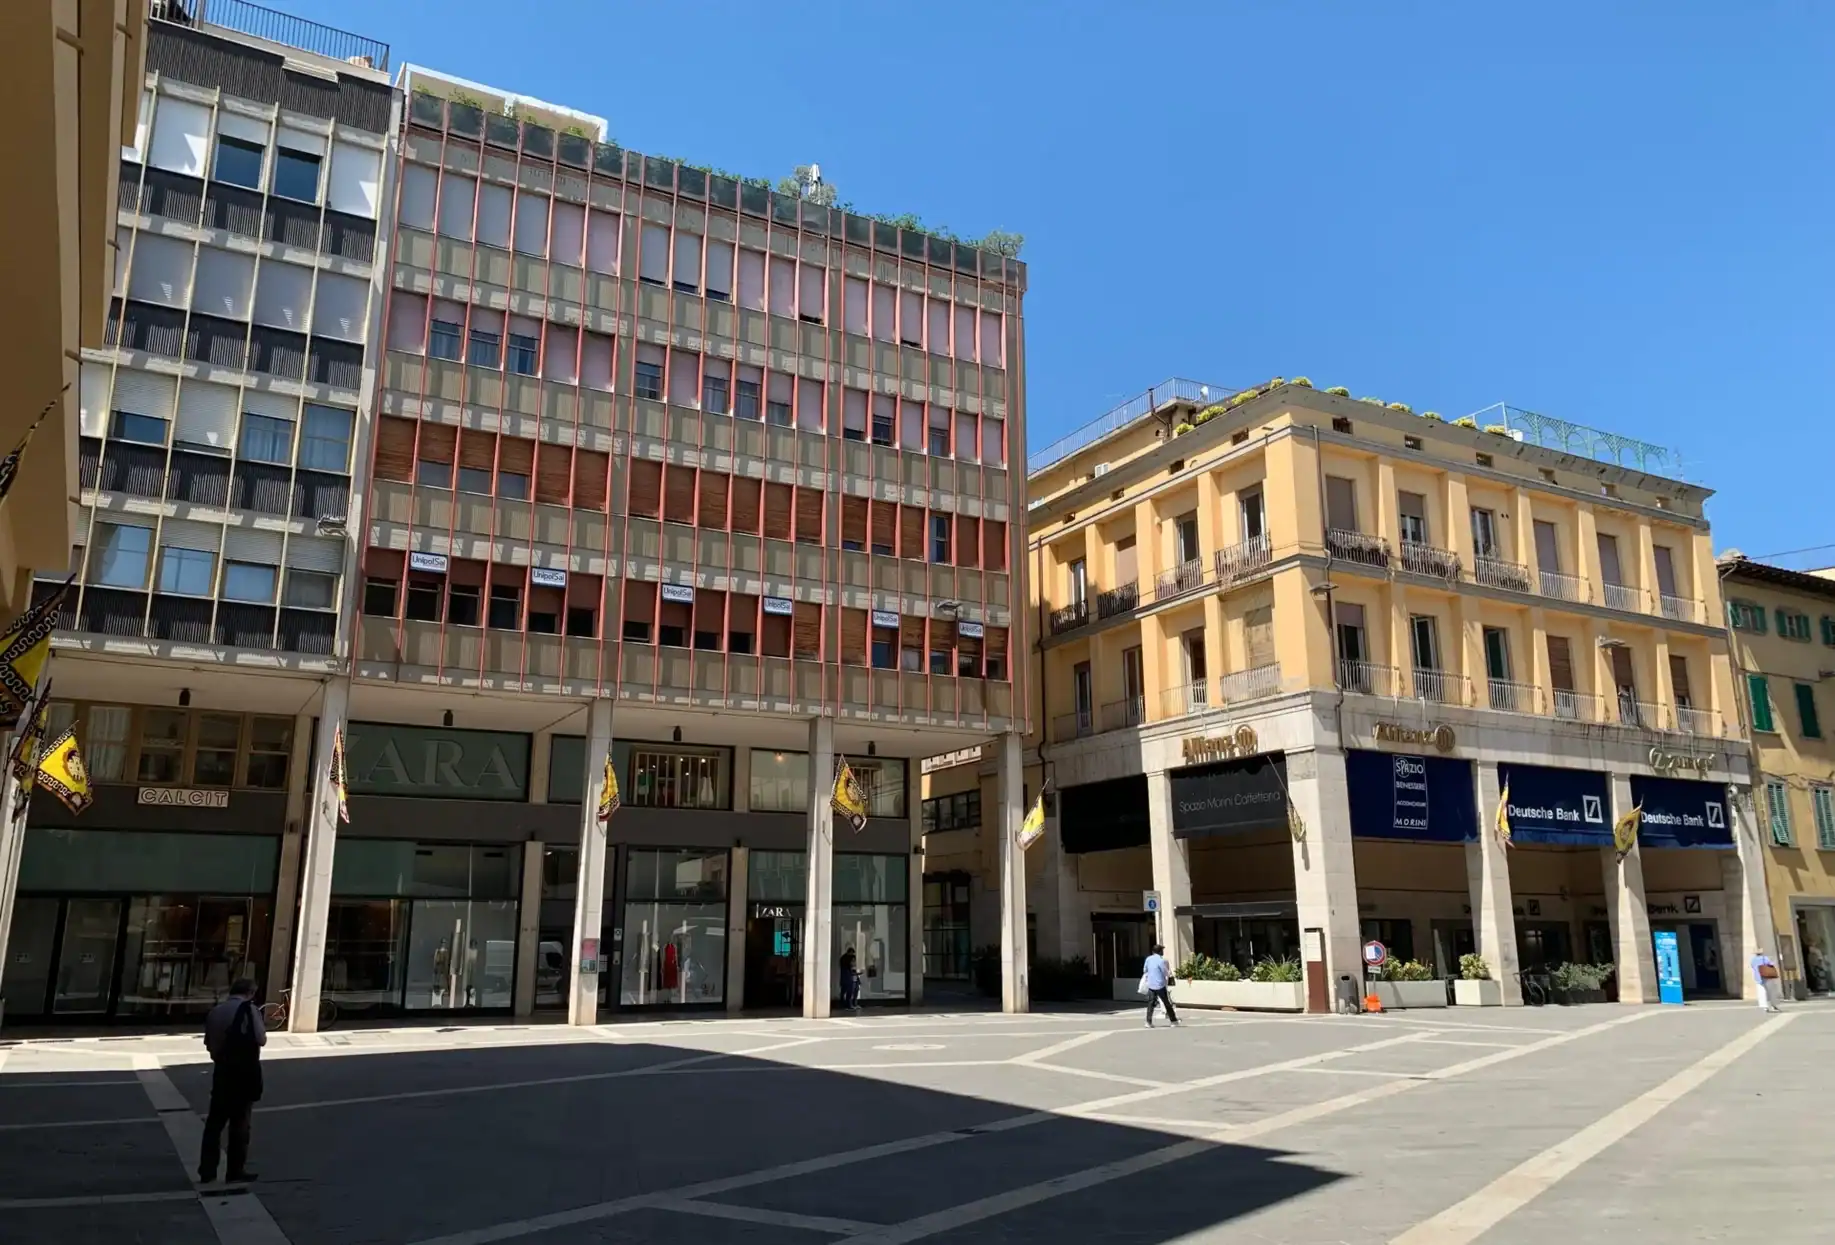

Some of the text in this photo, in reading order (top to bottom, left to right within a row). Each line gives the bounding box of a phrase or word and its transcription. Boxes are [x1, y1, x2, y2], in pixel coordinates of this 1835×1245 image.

[412, 554, 446, 567] UnipolSai
[533, 570, 565, 582] UnipolSai
[1395, 759, 1424, 775] SPAZIO
[141, 788, 228, 806] CALCIT
[1179, 790, 1281, 814] Spazio Morini Caffetteria
[1508, 803, 1580, 822] Deutsche Bank
[1641, 811, 1704, 827] Deutsche Bank
[1396, 817, 1427, 828] MORINI
